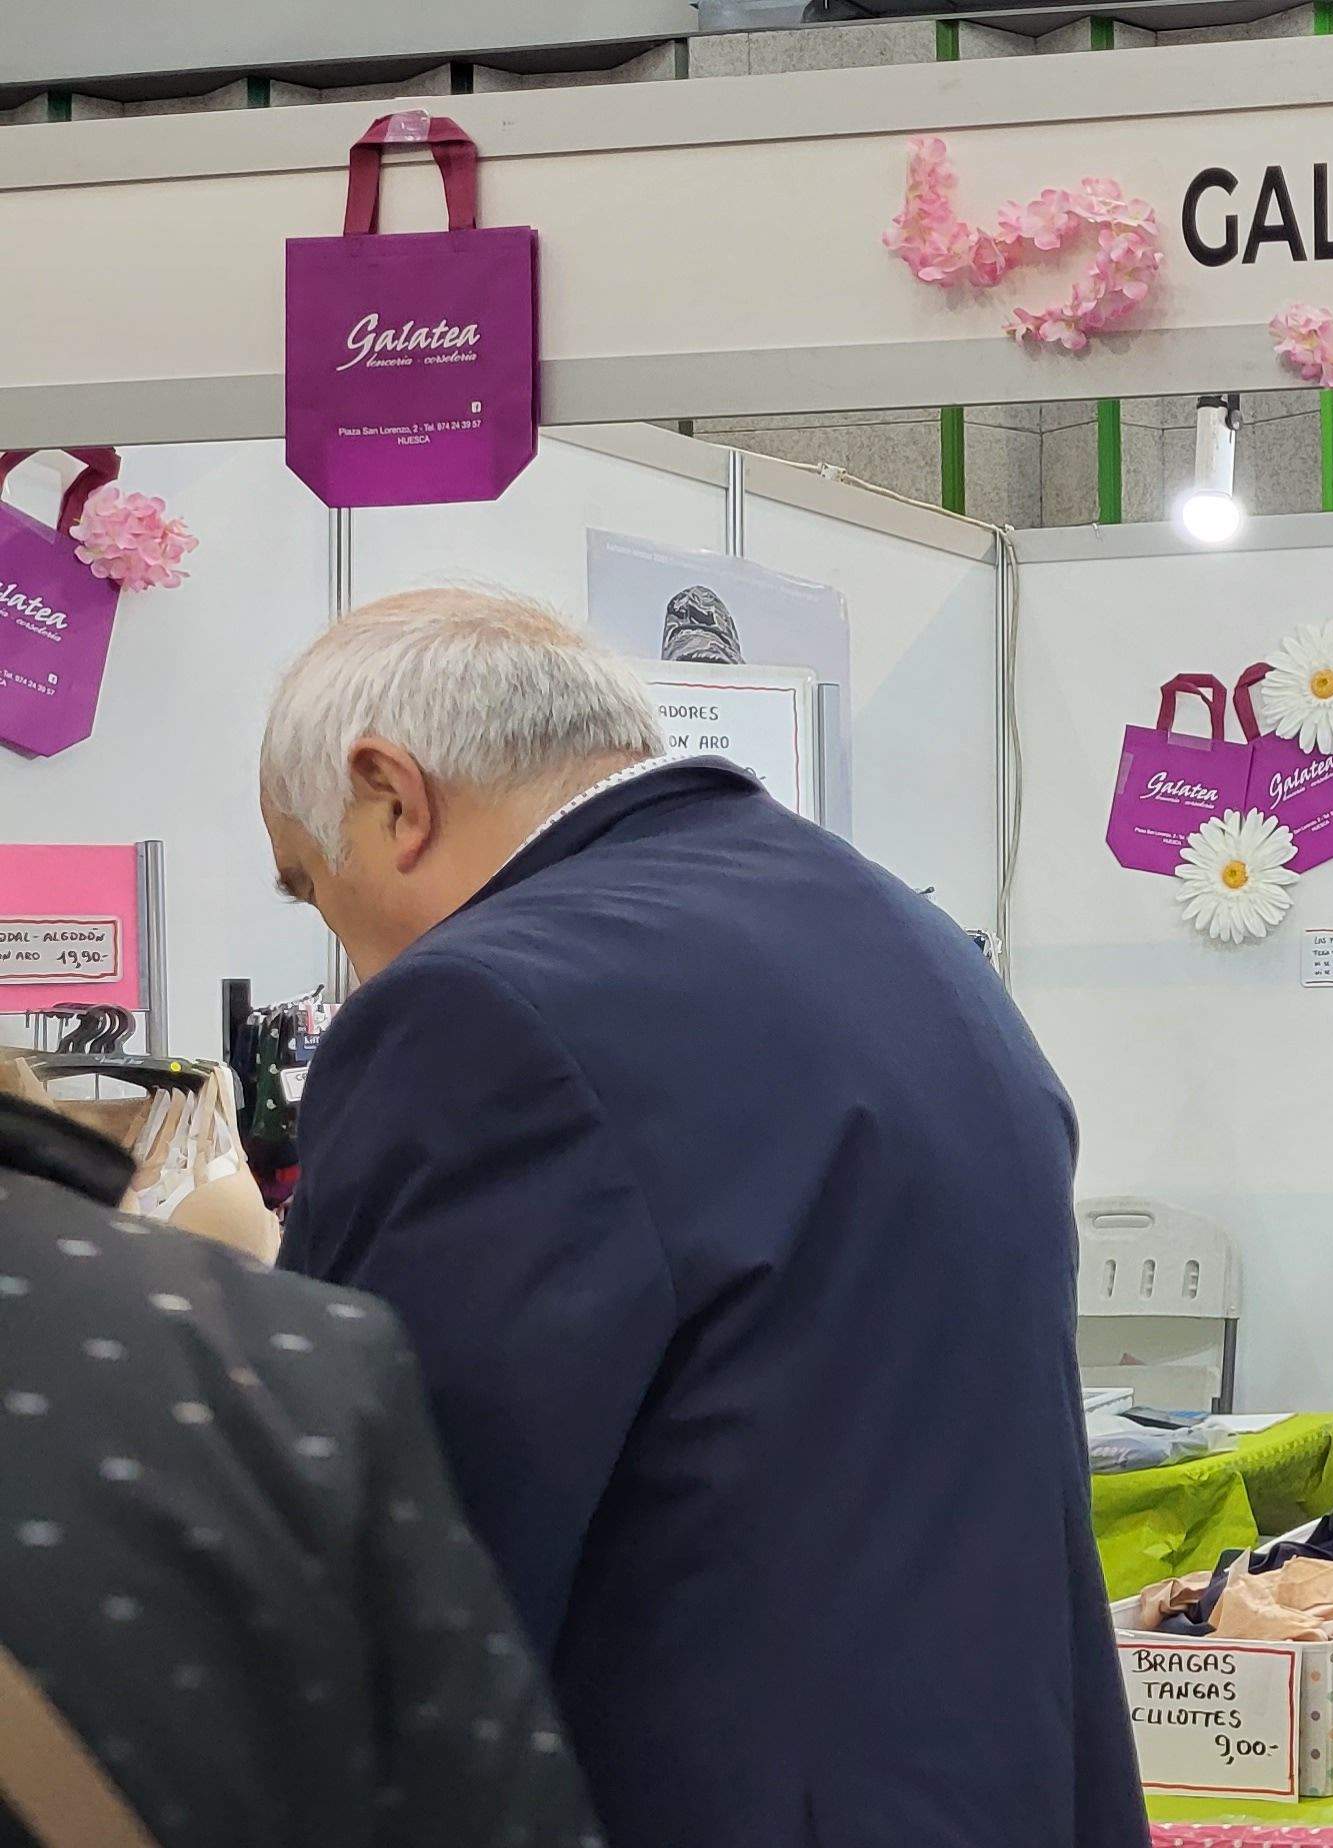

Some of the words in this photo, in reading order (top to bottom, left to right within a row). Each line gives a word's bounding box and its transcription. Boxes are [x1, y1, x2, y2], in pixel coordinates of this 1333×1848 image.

[336, 313, 480, 371] Galatea
[339, 428, 360, 437] Plaza
[362, 426, 378, 435] San
[413, 425, 419, 433] 2
[398, 435, 430, 445] HUESCA
[0, 583, 68, 629] latea
[659, 705, 719, 721] ADORES
[668, 735, 689, 748] ON
[700, 735, 730, 749] ARO
[1140, 771, 1218, 801] Galatea
[16, 951, 40, 961] ARO
[1132, 1650, 1236, 1674] BRAGAS
[1143, 1681, 1236, 1700] TANGAS
[1132, 1707, 1242, 1728] CULOTTES
